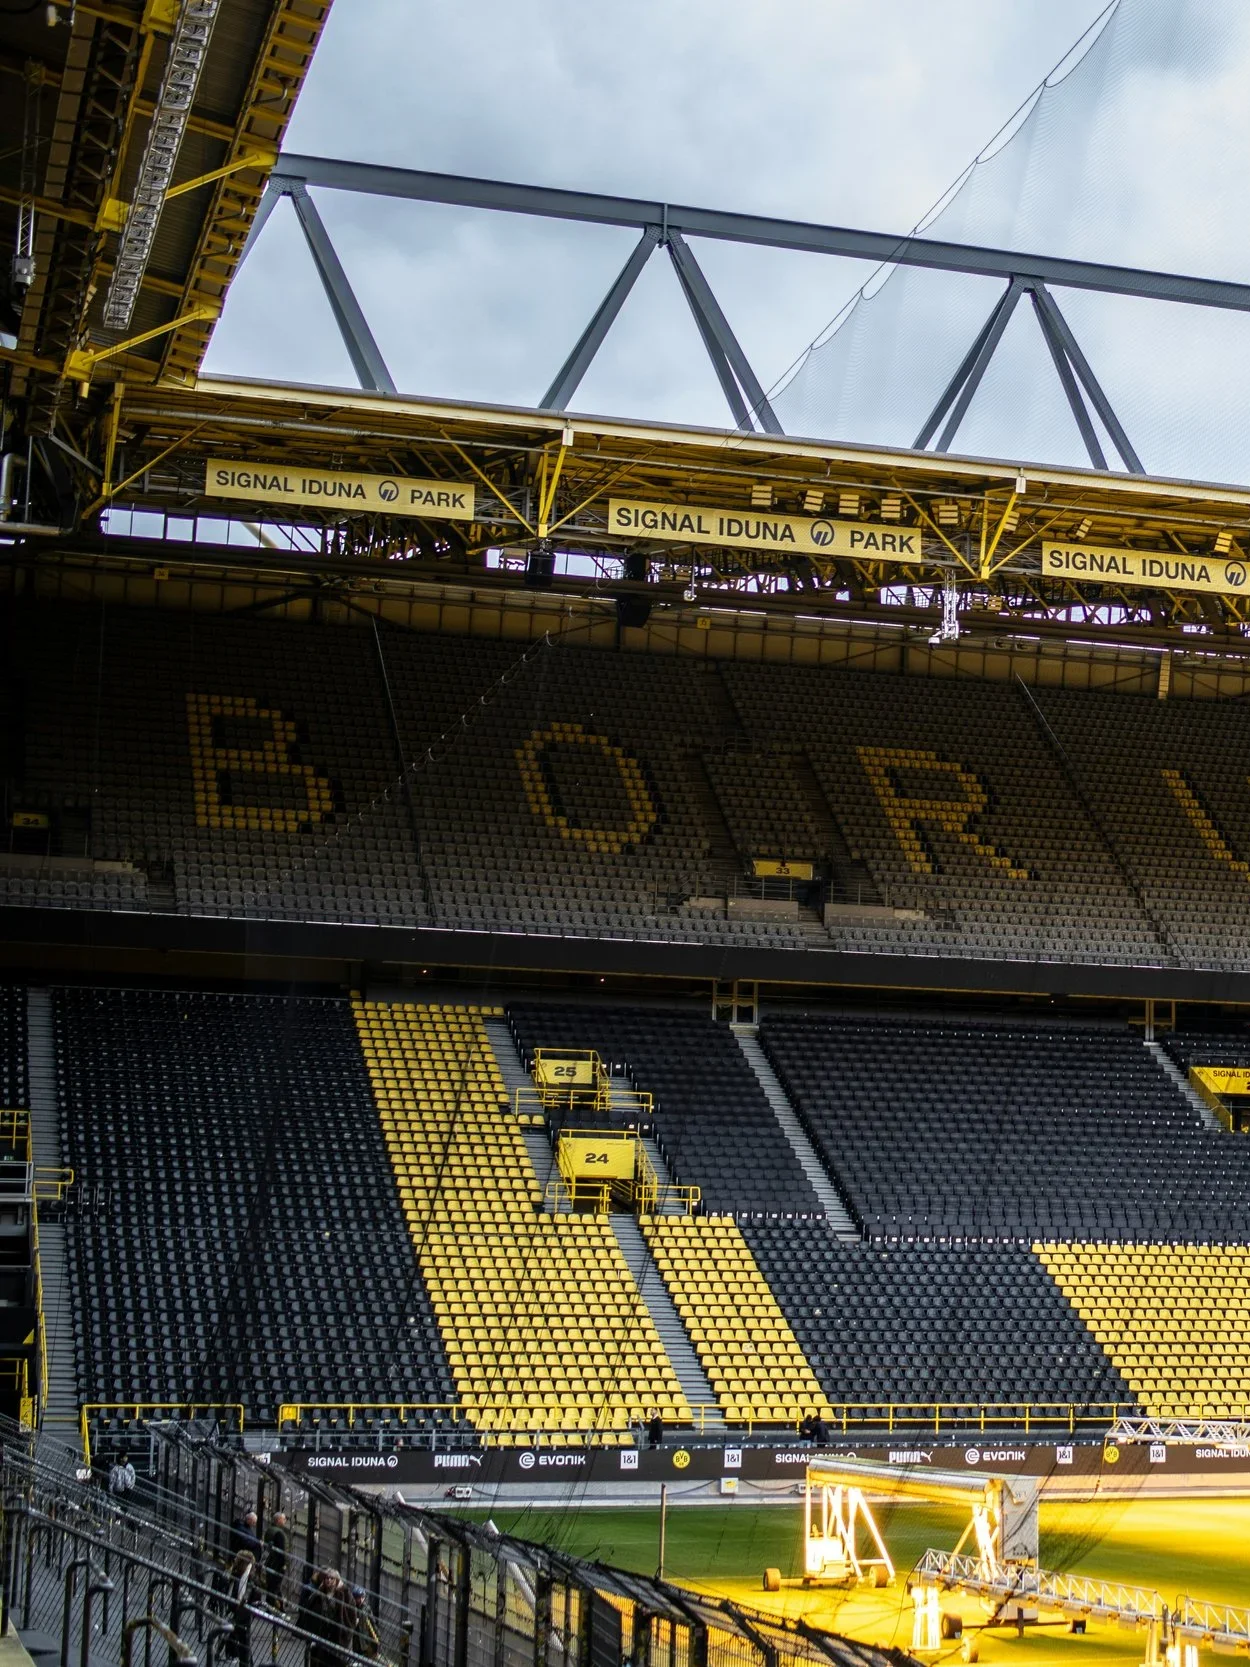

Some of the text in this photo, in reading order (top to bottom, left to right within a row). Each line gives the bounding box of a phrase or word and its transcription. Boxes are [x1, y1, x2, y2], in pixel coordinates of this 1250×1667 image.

[216, 470, 465, 508] SIGNAL IDUNA PARK
[616, 507, 914, 554] SIGNAL IDUNA PARK
[1049, 550, 1134, 575] SIGNAL
[1142, 558, 1211, 583] IDUNA
[775, 867, 790, 875] 33
[554, 1066, 577, 1077] 25
[1213, 1070, 1241, 1078] SIGNAL
[585, 1153, 609, 1164] 24
[727, 1454, 740, 1463] 1&1
[889, 1451, 921, 1463] PUMA
[983, 1452, 1026, 1461] EVONIK
[1152, 1450, 1164, 1458] 1&1
[1196, 1449, 1230, 1458] SIGNAL
[308, 1456, 386, 1467] SIGNAL IDUNA
[434, 1455, 469, 1467] PUMA
[538, 1455, 586, 1465] EVONIK
[623, 1455, 636, 1464] 1&1
